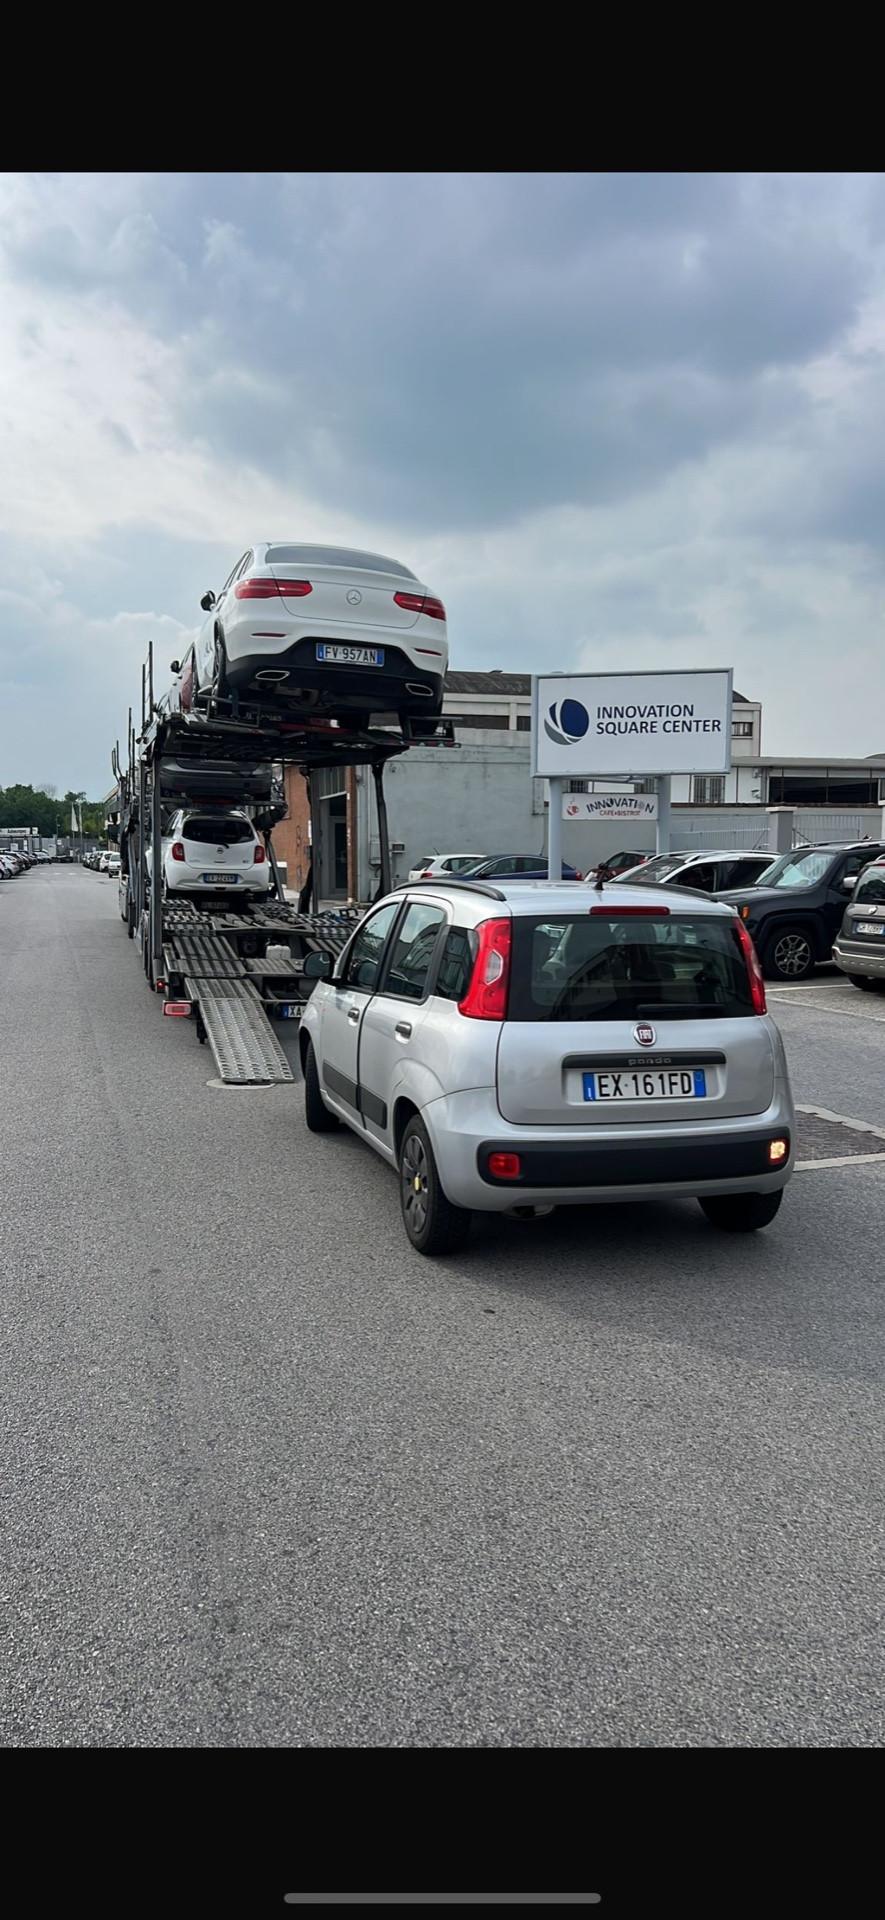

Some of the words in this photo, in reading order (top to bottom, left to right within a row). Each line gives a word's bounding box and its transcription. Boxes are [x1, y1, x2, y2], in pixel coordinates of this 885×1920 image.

[597, 704, 694, 719] INNOVATION
[596, 720, 658, 736] SQUARE
[662, 719, 721, 733] CENTER
[638, 1029, 652, 1040] FIAT
[597, 1074, 624, 1097] EX
[632, 1072, 692, 1096] 161FD
